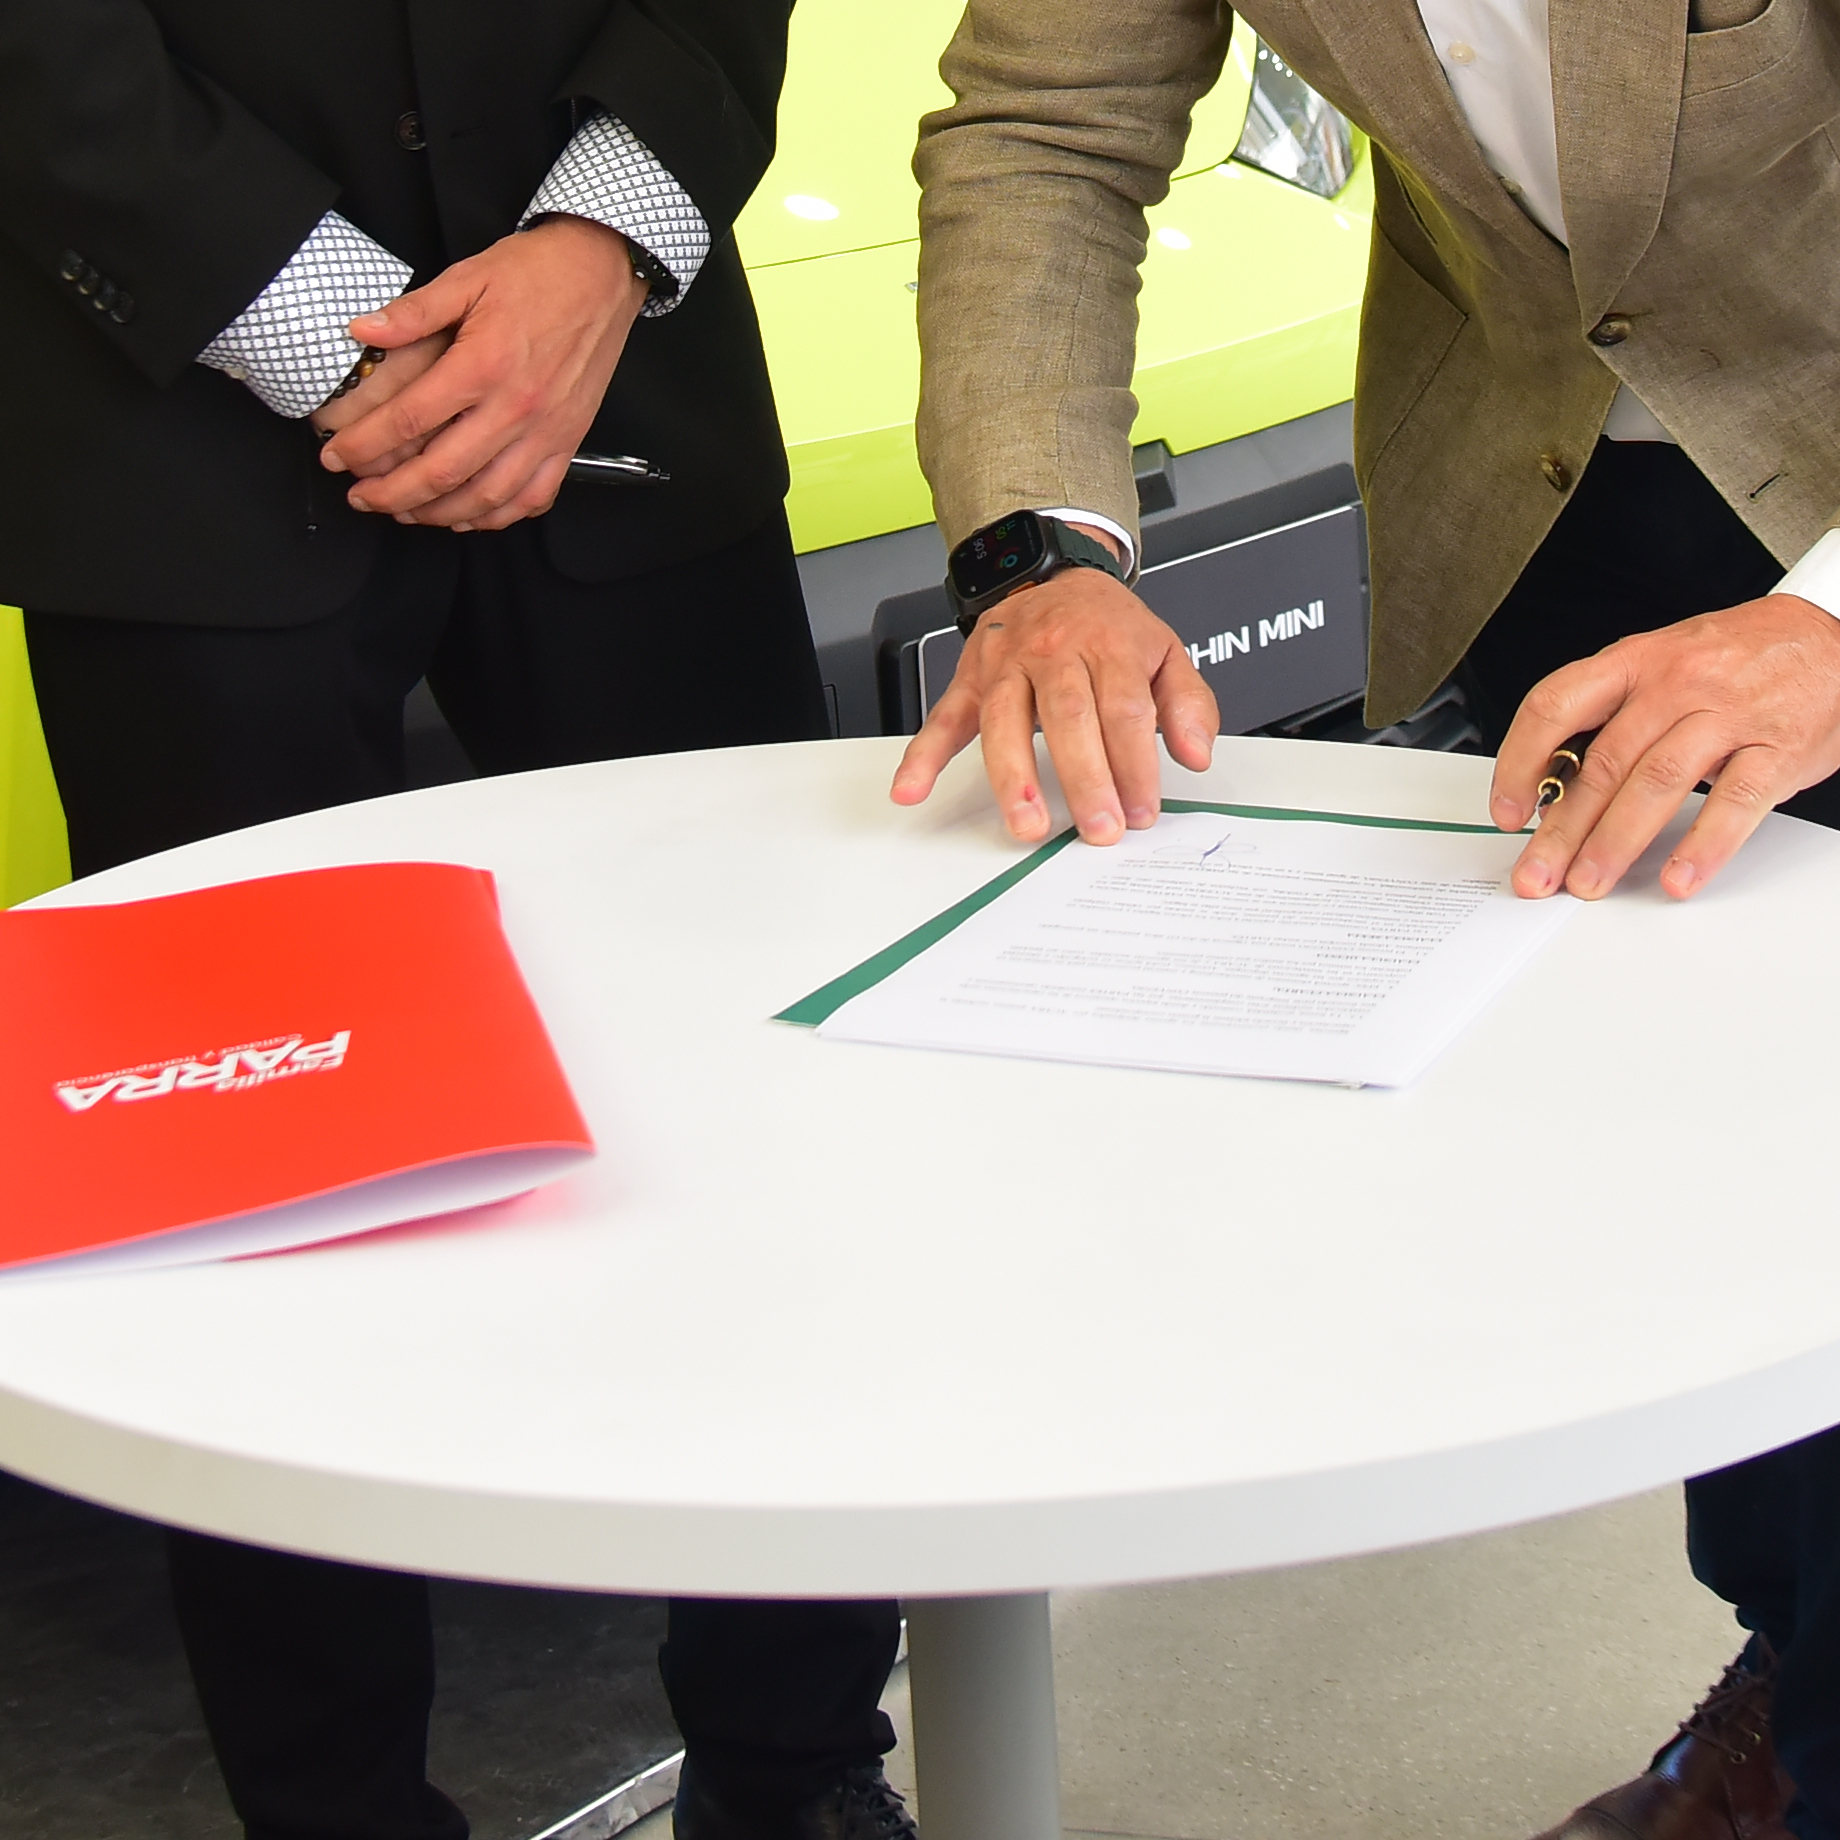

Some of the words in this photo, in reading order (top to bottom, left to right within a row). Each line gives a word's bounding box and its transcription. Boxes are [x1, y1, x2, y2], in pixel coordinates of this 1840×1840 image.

[1258, 600, 1325, 647] MINI
[56, 1030, 351, 1111] PARRA
[213, 1054, 345, 1092] Familia
